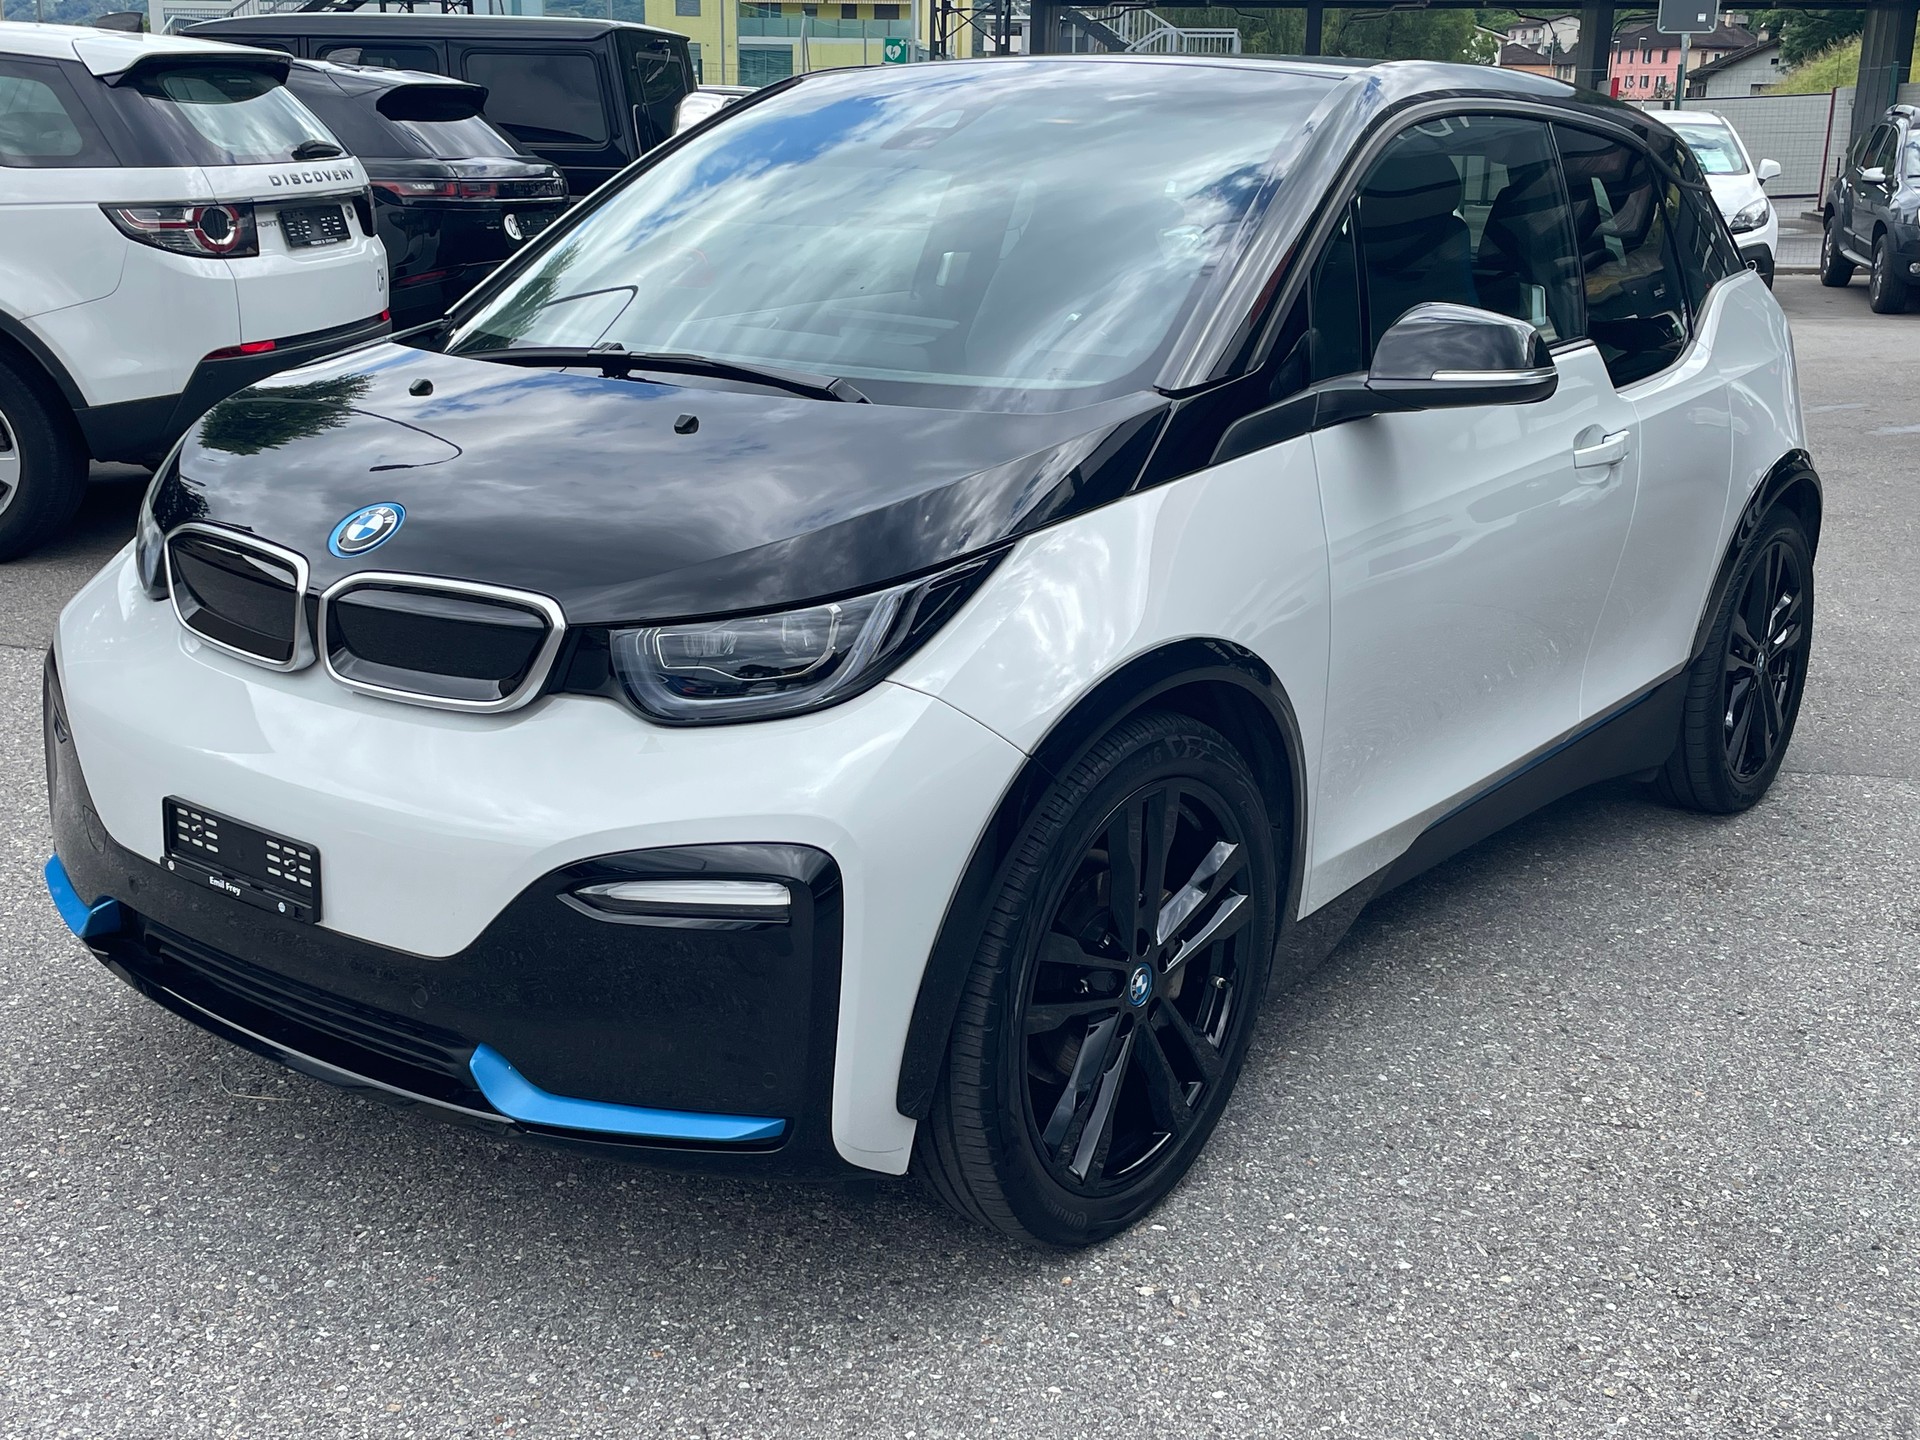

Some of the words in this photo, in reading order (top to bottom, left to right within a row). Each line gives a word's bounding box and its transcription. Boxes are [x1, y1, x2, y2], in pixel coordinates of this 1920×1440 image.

[268, 169, 354, 187] DISCOVERY
[359, 506, 396, 524] BMW
[209, 876, 225, 889] Emil
[225, 882, 241, 896] Frey
